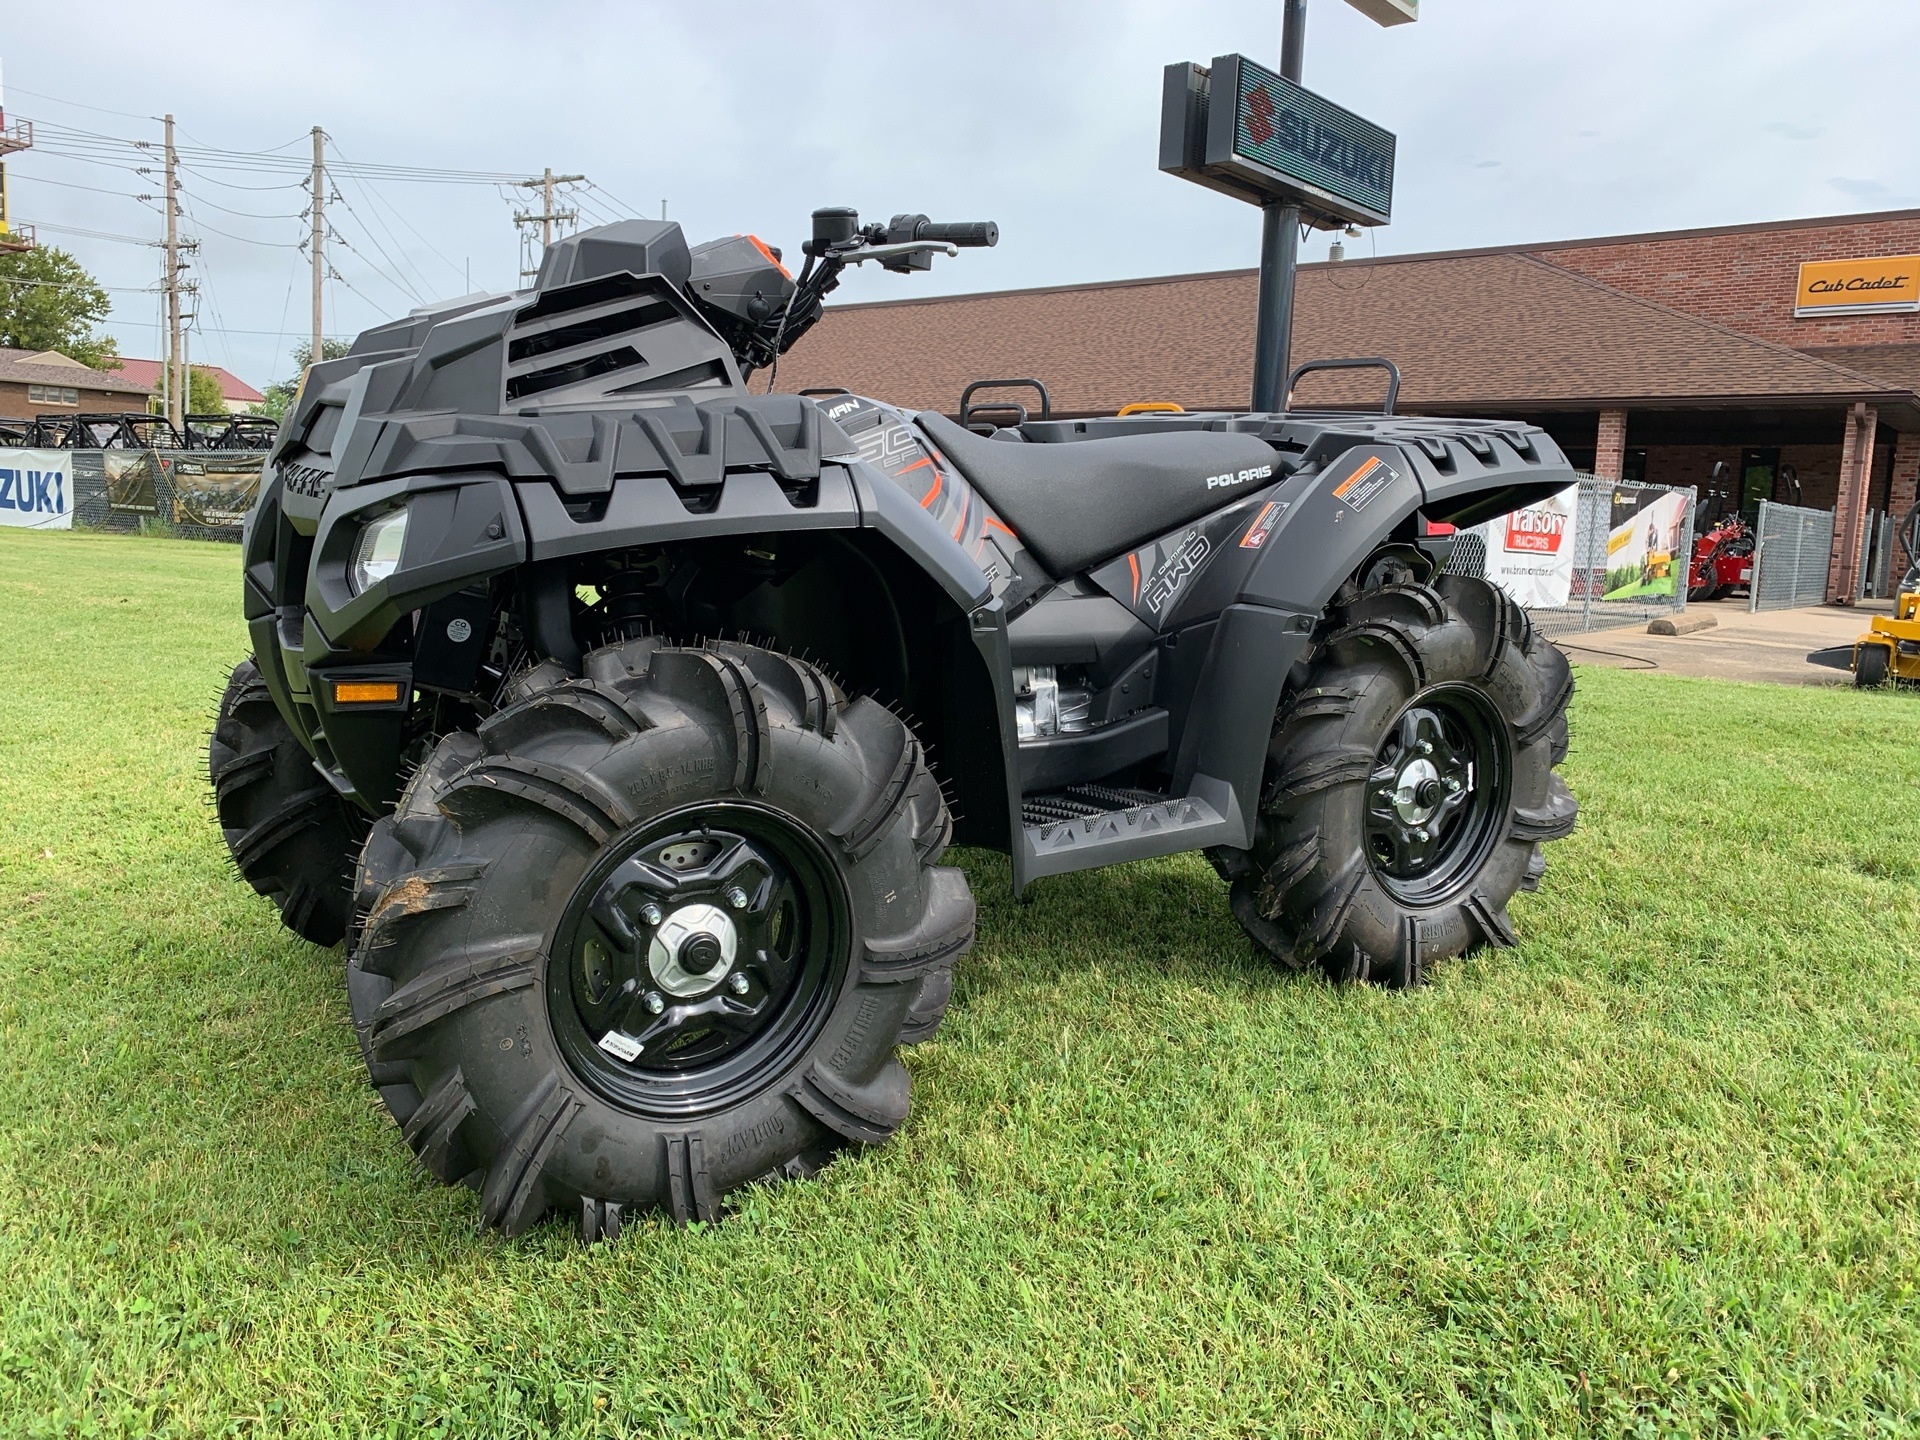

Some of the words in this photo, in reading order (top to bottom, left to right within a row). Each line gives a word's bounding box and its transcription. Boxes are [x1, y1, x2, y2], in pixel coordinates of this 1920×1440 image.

[1277, 109, 1387, 192] SUZUKI
[1808, 279, 1844, 293] Cub
[1846, 275, 1910, 290] Cadet
[1206, 464, 1272, 490] POLARIS
[1146, 535, 1211, 614] AWD
[1158, 531, 1197, 576] DEMAND
